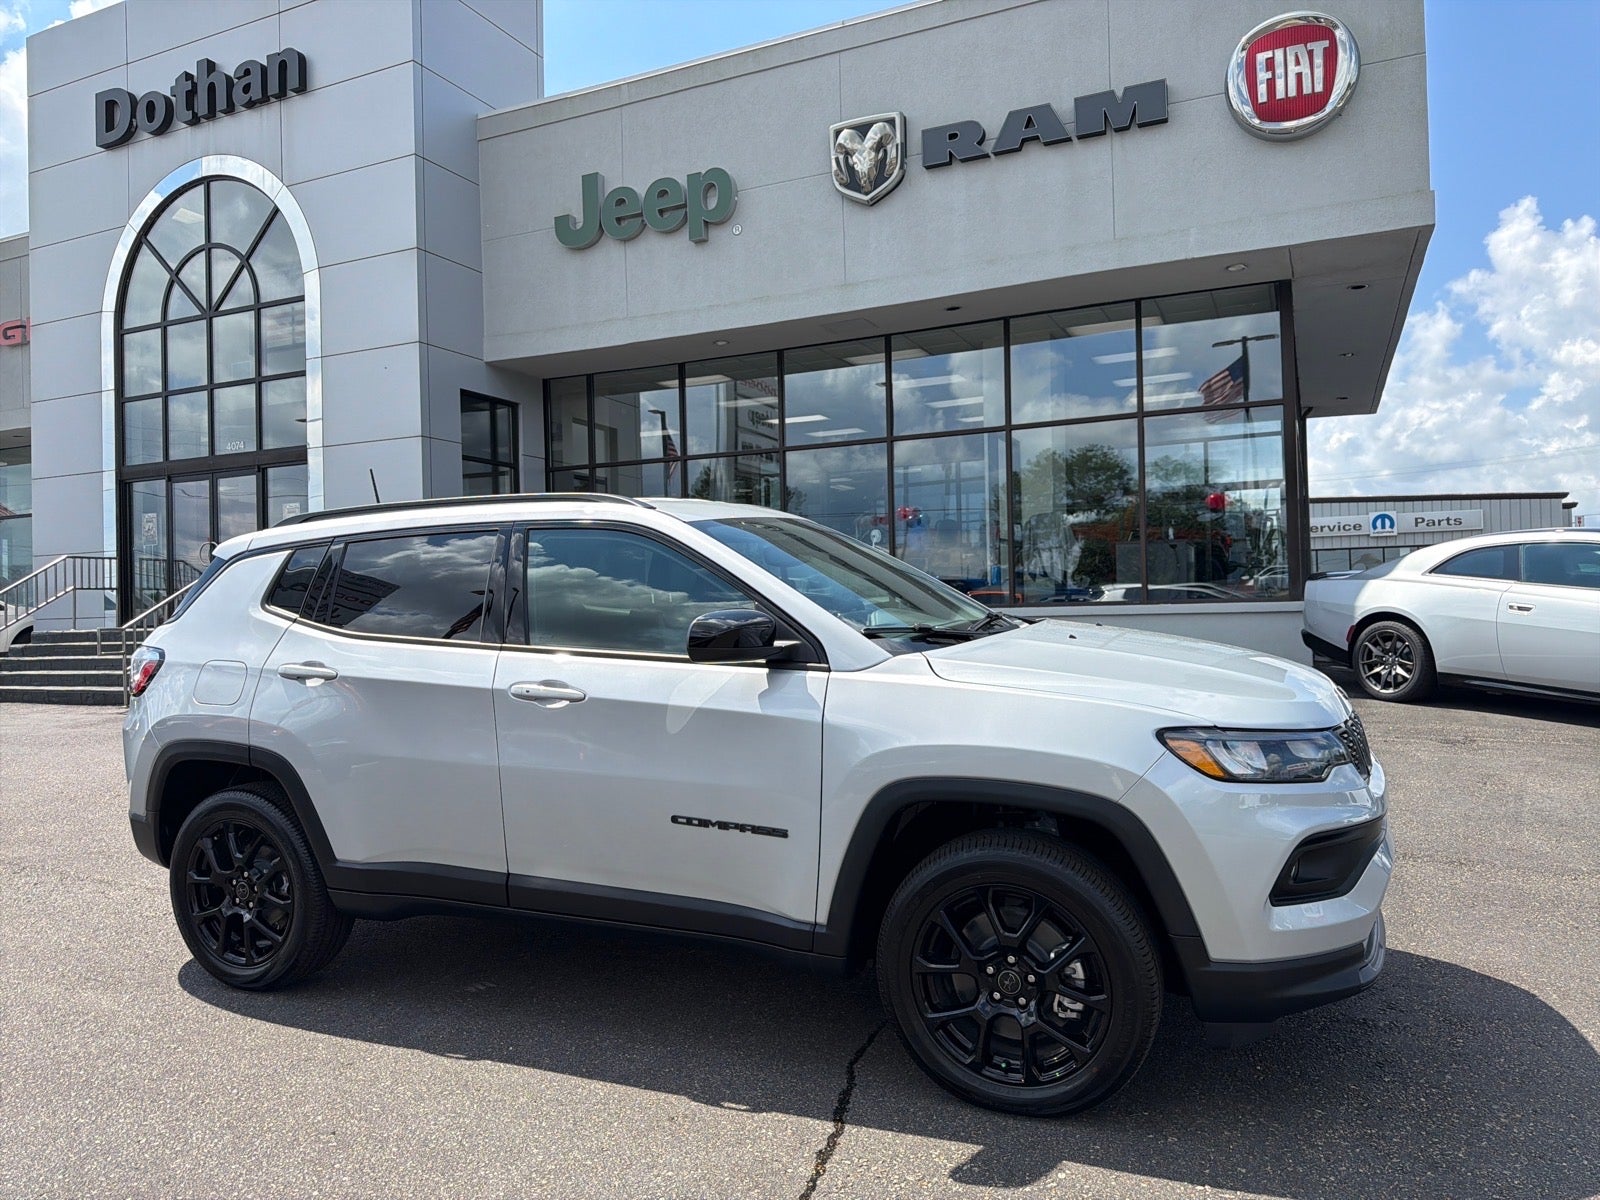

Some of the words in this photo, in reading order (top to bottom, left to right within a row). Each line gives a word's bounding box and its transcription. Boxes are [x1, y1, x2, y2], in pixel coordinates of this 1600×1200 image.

[1255, 40, 1330, 104] FIAT
[95, 47, 307, 149] Dothan
[922, 78, 1169, 169] RAM
[554, 167, 738, 249] Jeep
[226, 440, 245, 451] 4074
[1310, 522, 1363, 533] ervice
[1414, 516, 1463, 528] Parts
[671, 815, 789, 839] COMPASS
